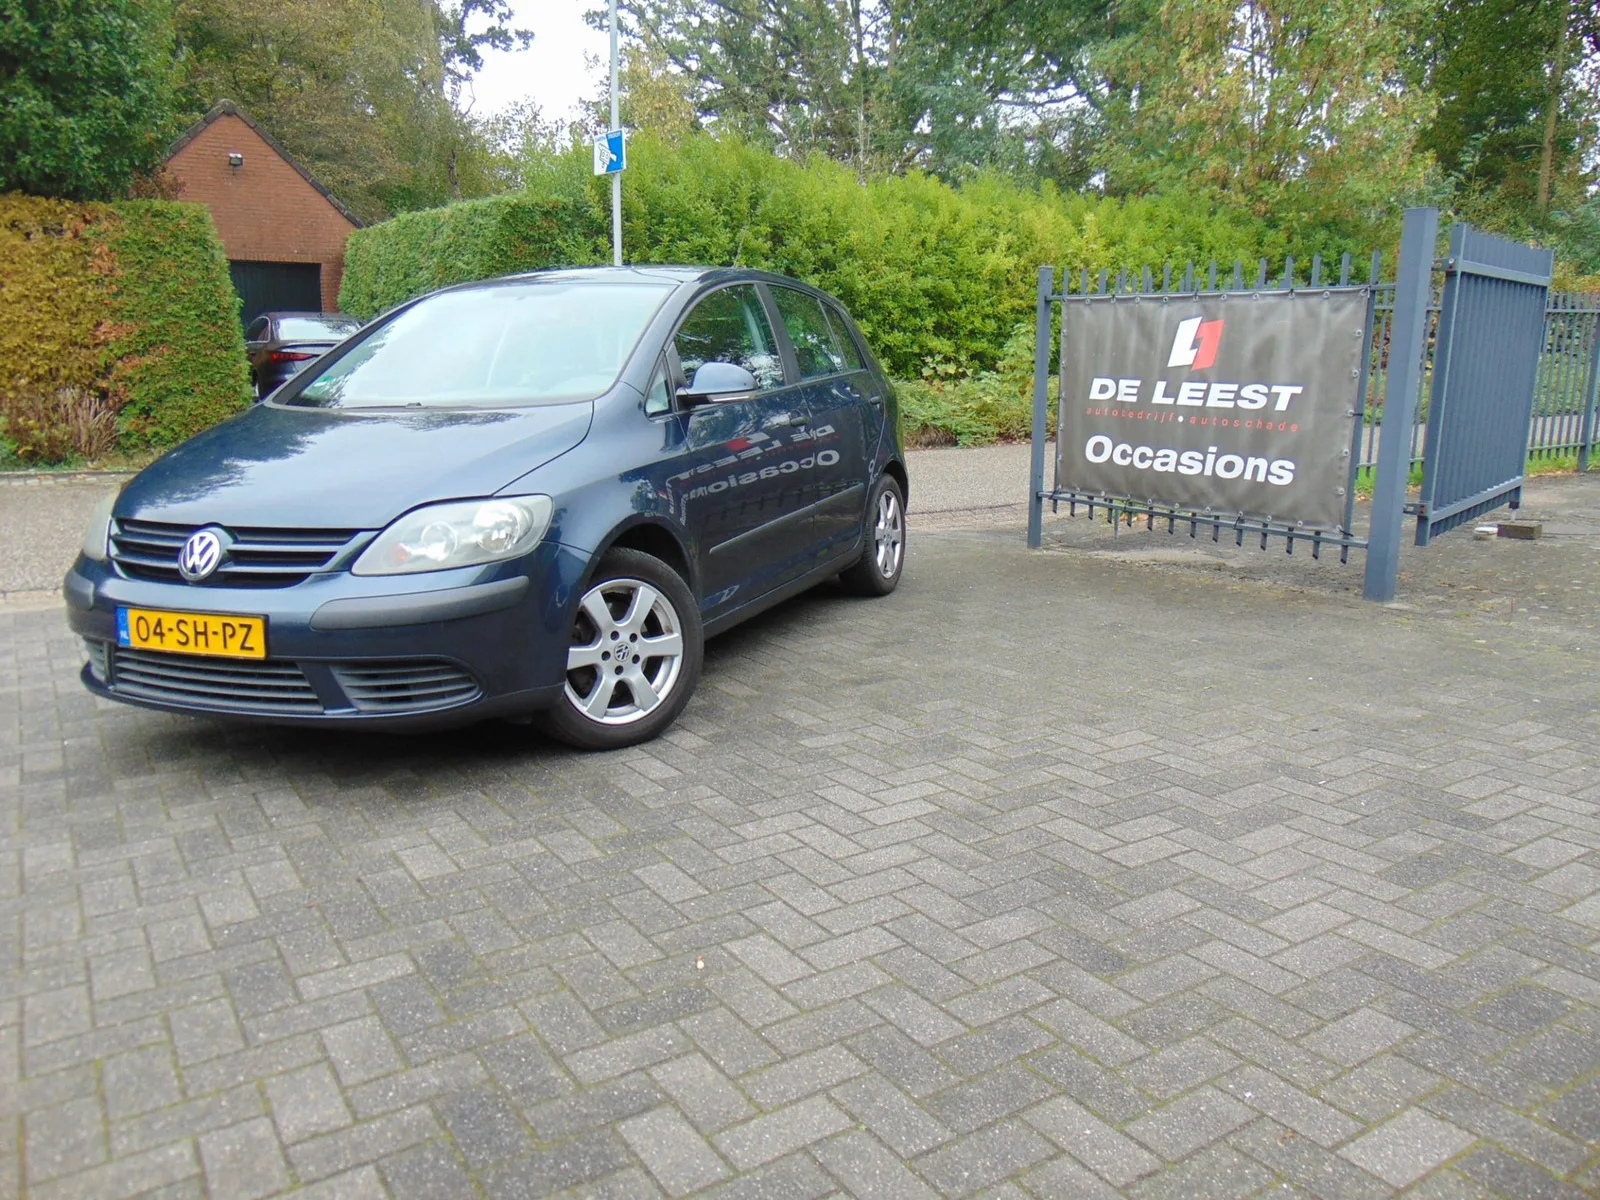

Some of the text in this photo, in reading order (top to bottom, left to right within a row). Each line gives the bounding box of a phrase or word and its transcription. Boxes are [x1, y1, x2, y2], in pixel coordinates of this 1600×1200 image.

[1089, 377, 1303, 411] DE LEEST
[1189, 415, 1298, 433] autoschade
[1085, 434, 1296, 486] Occasions
[135, 615, 255, 652] 04-SH-PZ
